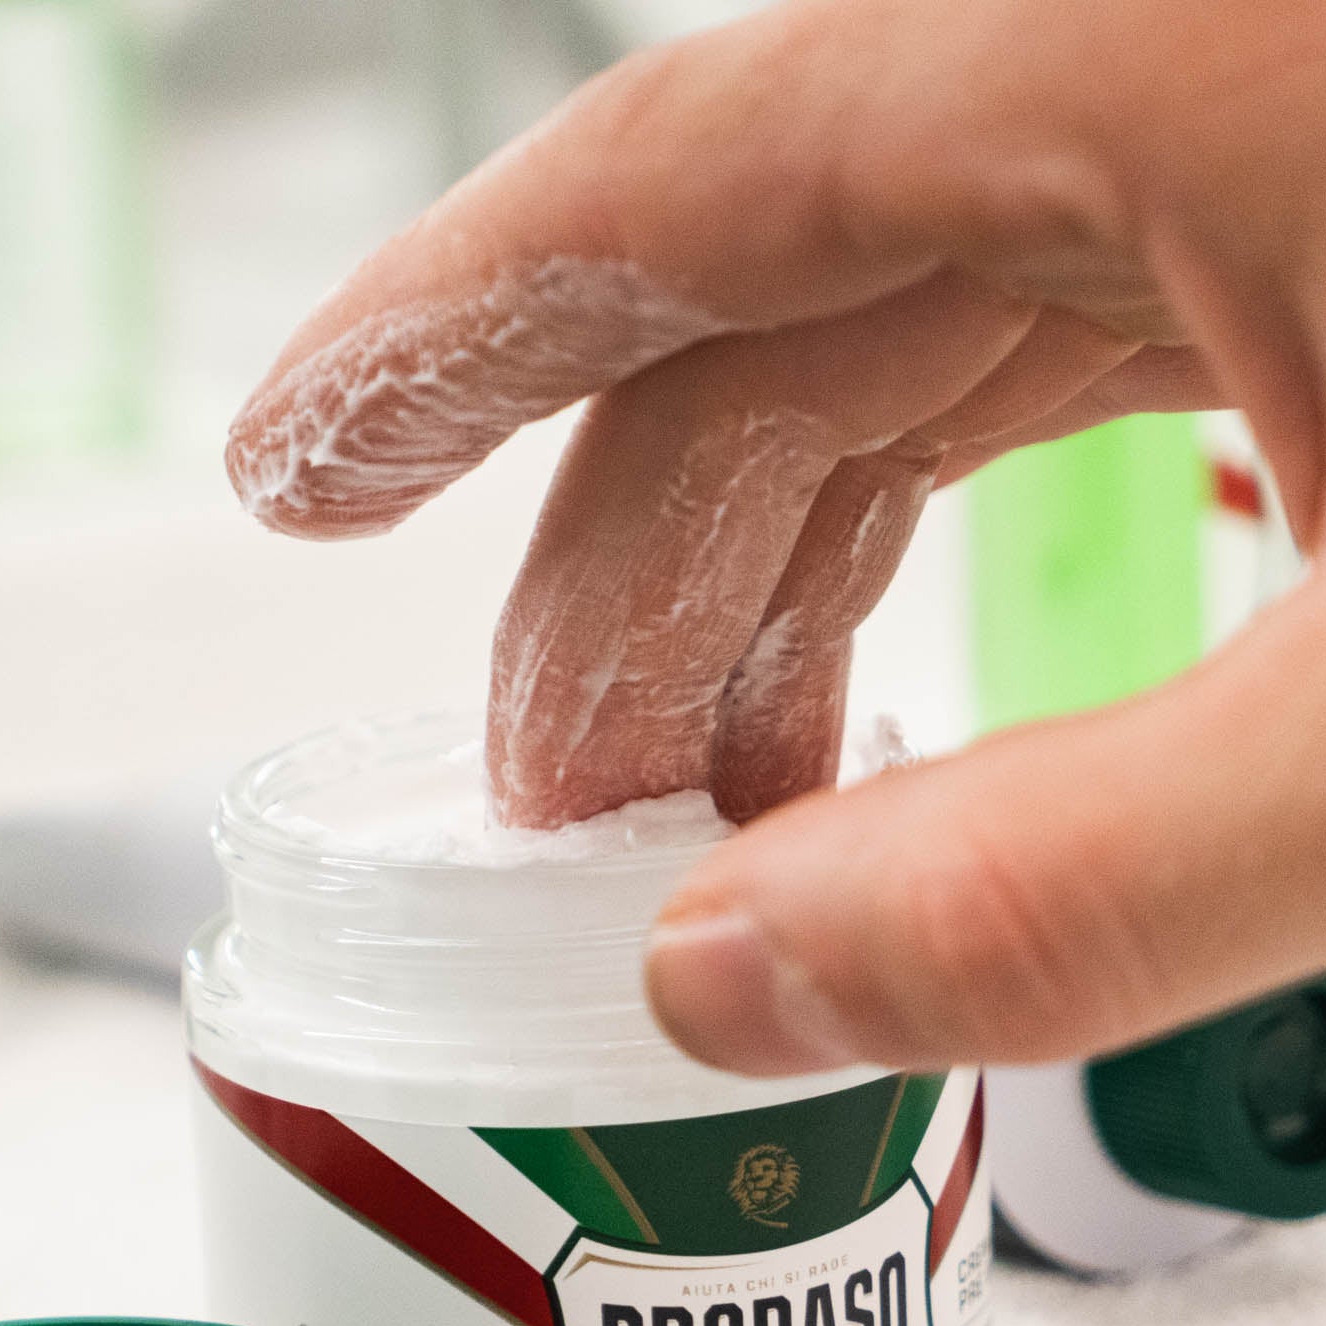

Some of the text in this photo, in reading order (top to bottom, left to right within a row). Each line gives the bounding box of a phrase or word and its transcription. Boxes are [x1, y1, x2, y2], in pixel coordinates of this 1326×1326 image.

[681, 1253, 851, 1298] AIUTA CHI SI RADE
